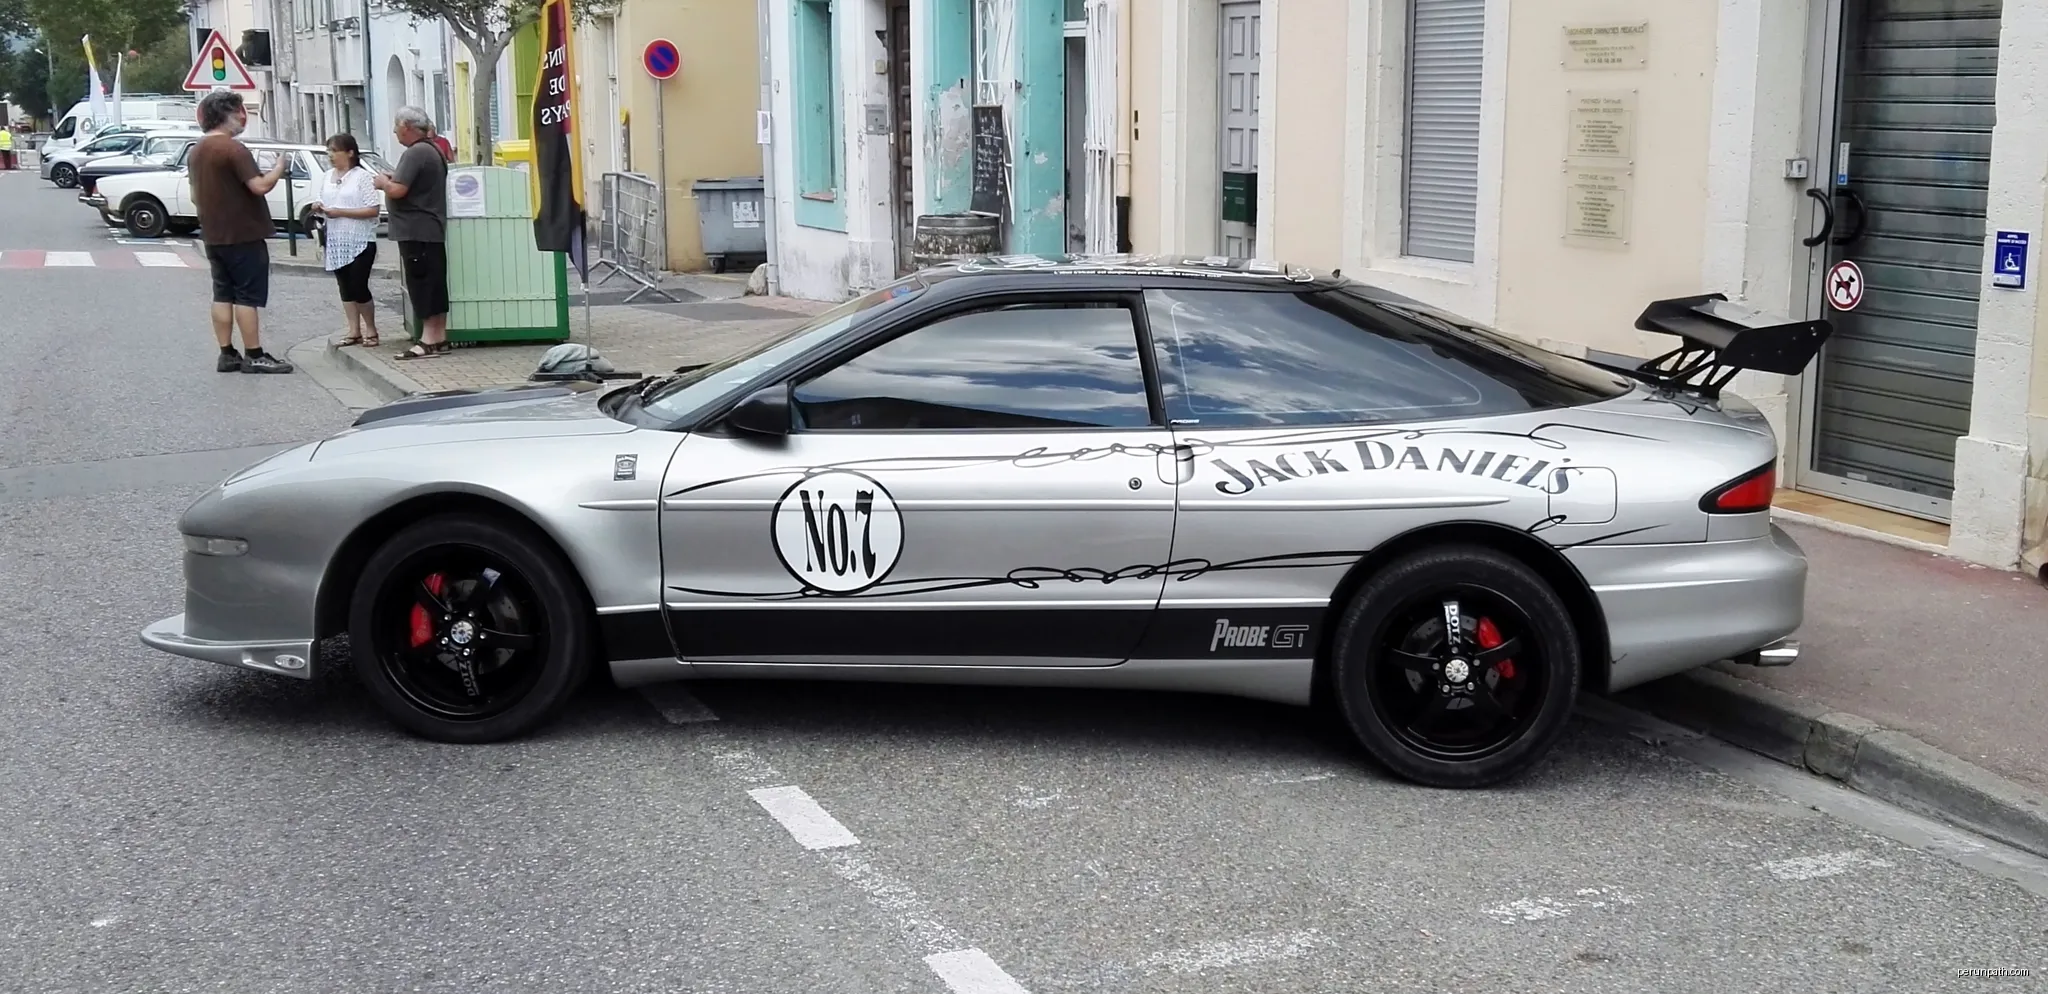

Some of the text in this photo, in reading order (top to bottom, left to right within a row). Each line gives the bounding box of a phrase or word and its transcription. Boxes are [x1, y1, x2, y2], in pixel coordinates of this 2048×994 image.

[1210, 440, 1584, 495] JACK DANIEL'S
[1210, 618, 1309, 652] PROBE GT
[1449, 604, 1461, 644] DOTZ
